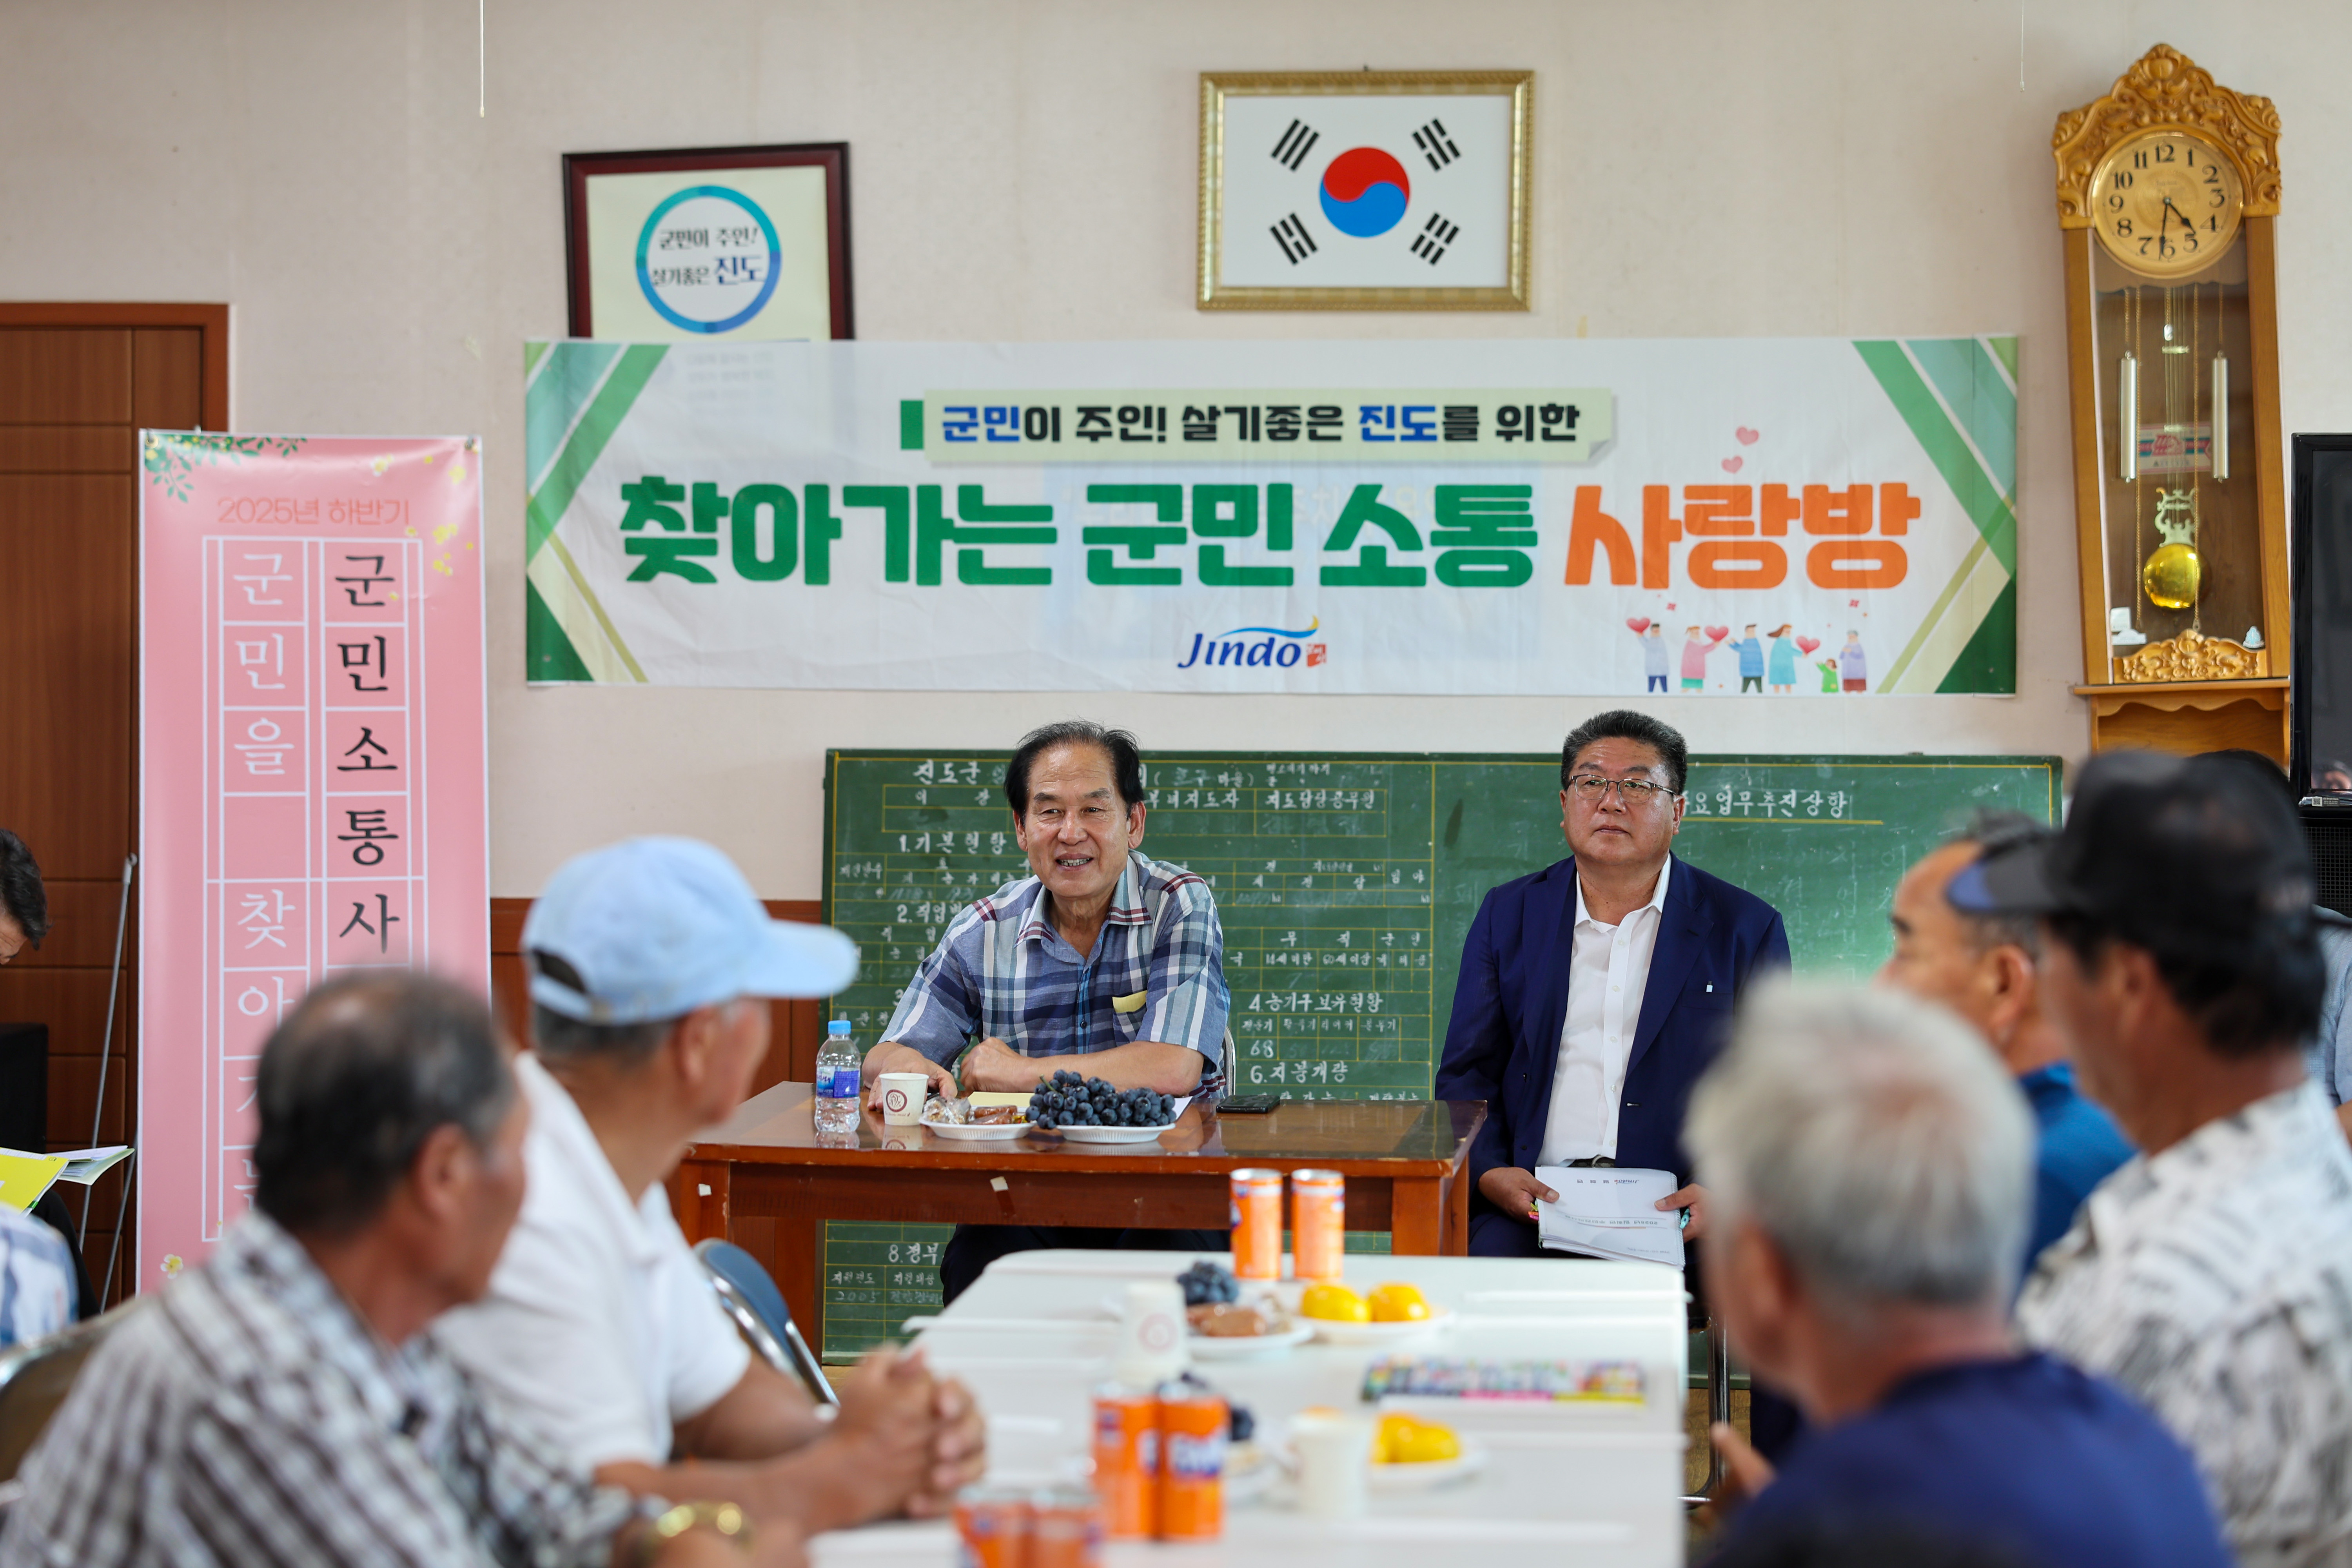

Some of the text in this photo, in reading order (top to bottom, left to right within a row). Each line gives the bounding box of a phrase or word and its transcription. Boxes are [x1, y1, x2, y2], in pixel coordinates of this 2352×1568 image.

[2134, 149, 2148, 169] 11
[2156, 143, 2174, 163] 12
[2187, 147, 2194, 167] 1
[2113, 171, 2133, 190] 10
[2202, 165, 2219, 184] 2
[2109, 195, 2123, 214] 9
[2209, 189, 2225, 208] 3
[2117, 218, 2132, 238] 8
[2200, 214, 2217, 232] 4
[659, 226, 758, 250] 군민이 주인!
[2138, 236, 2154, 256] 7
[2183, 234, 2198, 253] 5
[2162, 238, 2176, 259] 6
[652, 255, 765, 287] 살기좋은 진도
[942, 404, 1580, 443] 군민이 주인! 살기좋은 진도를 위한
[217, 496, 410, 526] 2025년 하반기
[620, 476, 1921, 590] 찾아가는 군민 소통 사랑방
[1177, 632, 1301, 669] Jindo
[233, 554, 295, 775] 군민을
[913, 759, 981, 785] 진도군
[1250, 1039, 1274, 1058] 68
